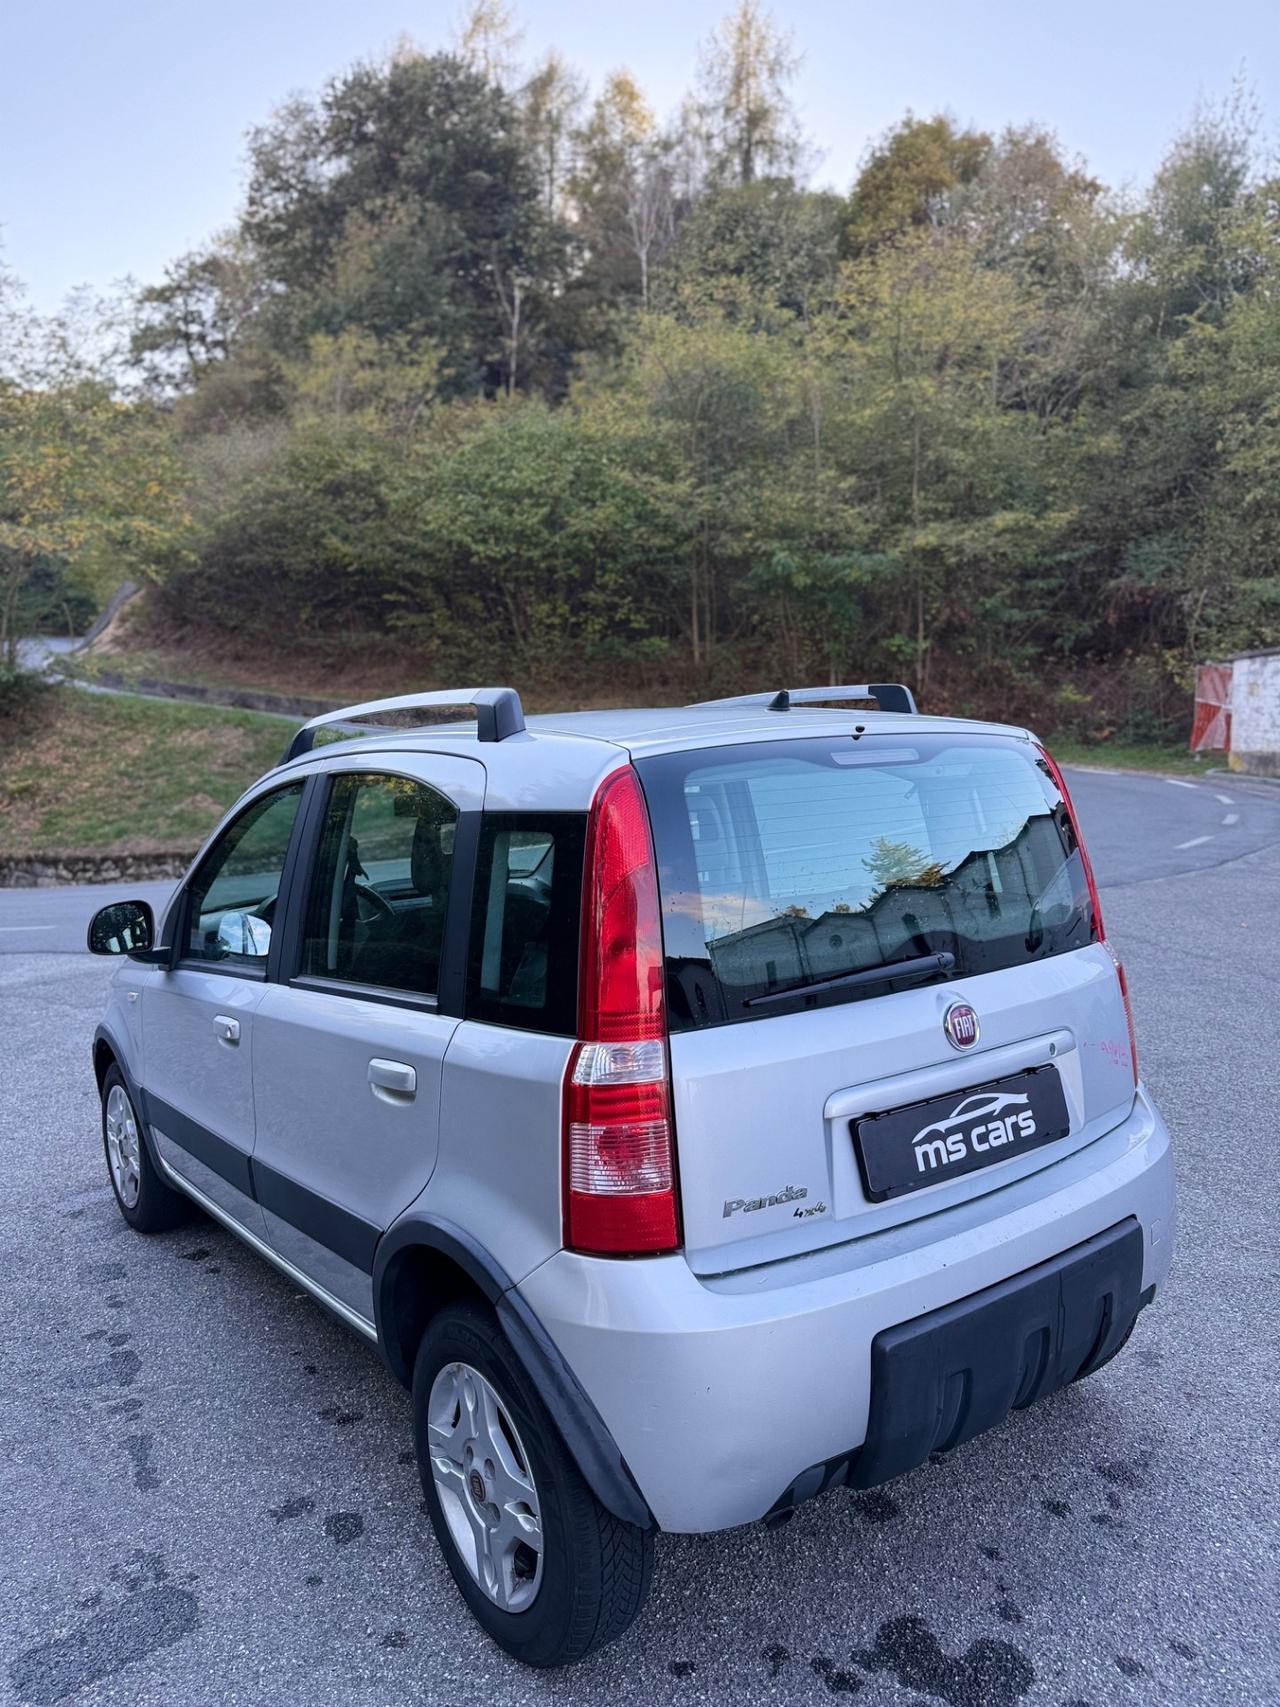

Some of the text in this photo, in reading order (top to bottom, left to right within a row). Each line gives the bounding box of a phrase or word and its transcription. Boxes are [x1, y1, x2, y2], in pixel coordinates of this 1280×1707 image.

[954, 1014, 974, 1040] FIAT
[914, 1109, 1036, 1172] ms cars
[723, 1185, 808, 1218] Panda
[793, 1202, 826, 1218] 4x4
